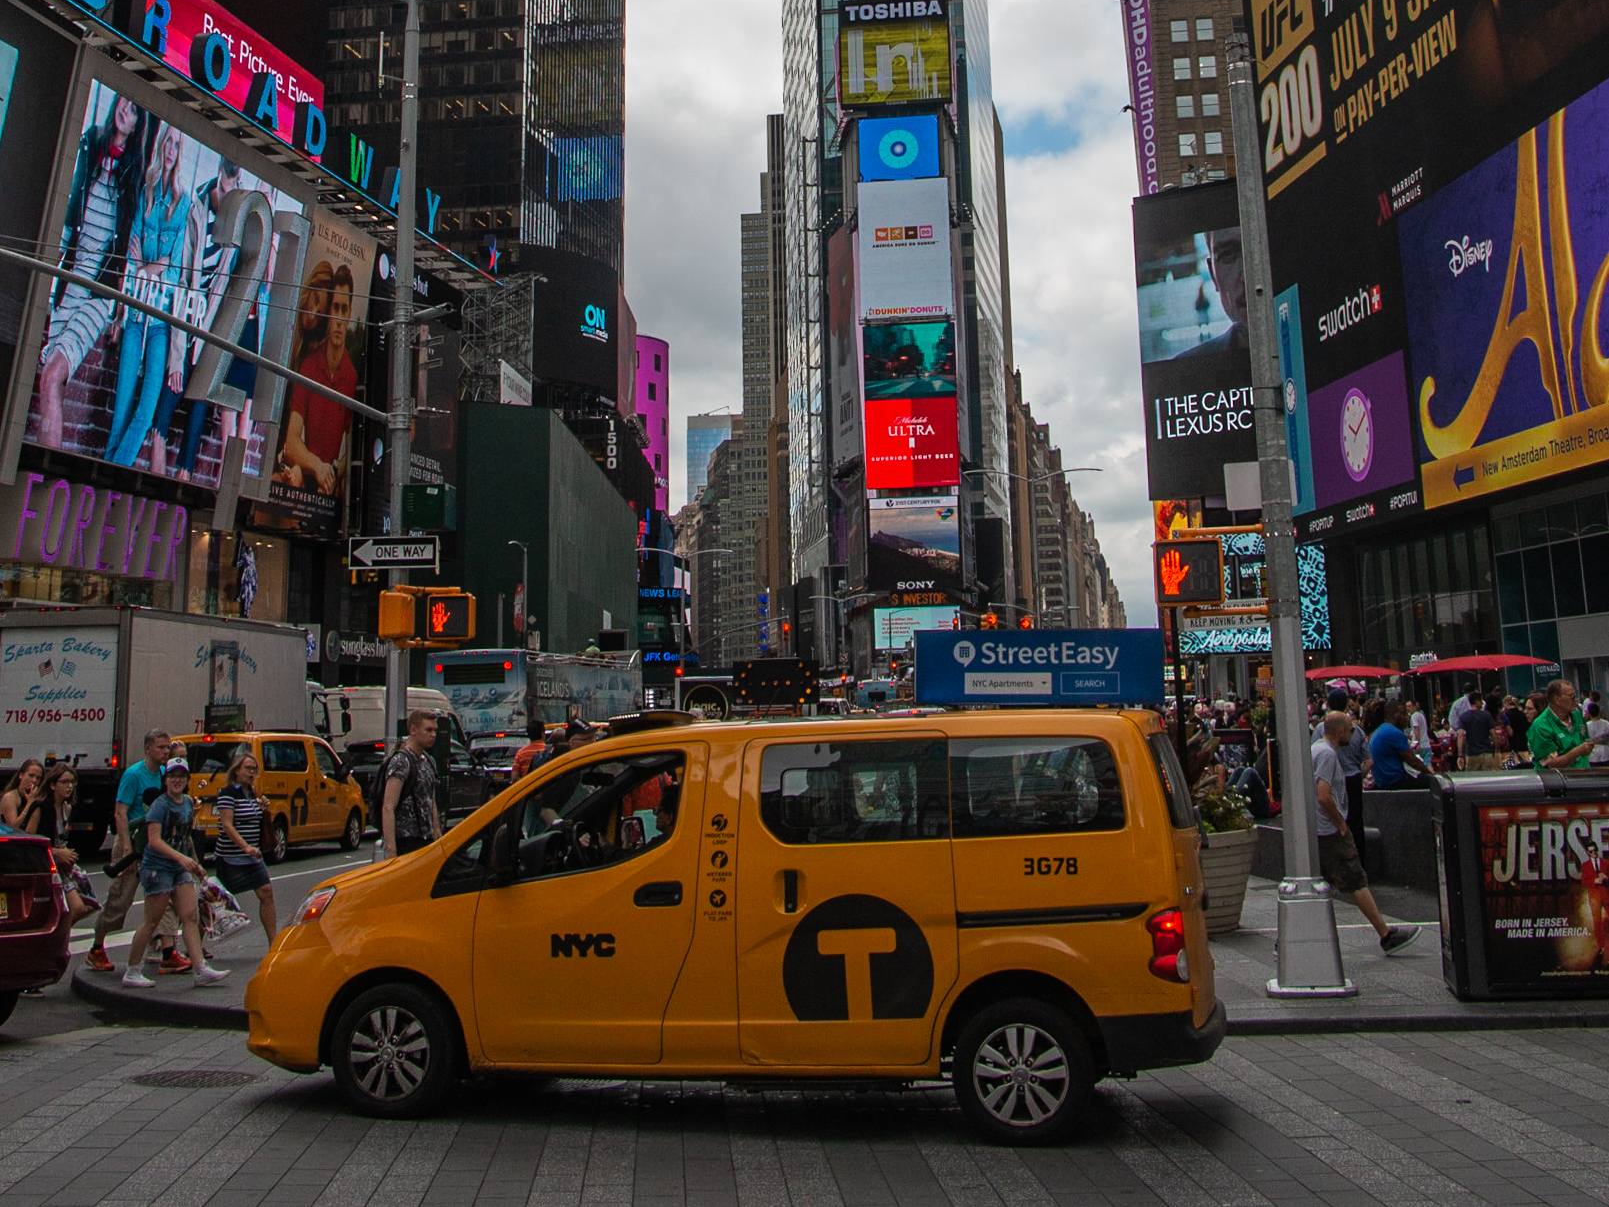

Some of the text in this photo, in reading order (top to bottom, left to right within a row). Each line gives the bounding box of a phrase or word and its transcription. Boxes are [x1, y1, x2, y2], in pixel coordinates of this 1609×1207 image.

[845, 0, 943, 22] TOSHIBA
[1333, 9, 1458, 134] ON PAY-PER-VIEW
[1261, 45, 1323, 174] 200
[1391, 166, 1424, 197] MARRIOTT
[1392, 184, 1422, 212] MARQUIS
[330, 231, 349, 252] POLO
[584, 304, 606, 330] ON
[875, 305, 944, 316] DUNKIN' DONUTS
[1318, 288, 1371, 342] swatch
[1164, 394, 1199, 416] THE
[888, 424, 936, 437] ULTRA
[1166, 409, 1253, 438] LEXUS RC
[606, 419, 617, 469] 1500
[1481, 461, 1499, 477] New
[1501, 446, 1548, 472] Amsterdam
[1548, 435, 1588, 457] Theatre,
[286, 490, 336, 508] AUTHENTICALLY
[1345, 502, 1371, 523] swatch
[13, 472, 187, 581] FOREVER
[375, 545, 426, 558] ONE WAY
[639, 588, 665, 599] NEWS
[896, 580, 936, 590] SONY
[1190, 614, 1236, 628] KEEP MOVING
[3, 637, 112, 663] Sparta Bakery
[340, 635, 376, 662] sunglass
[643, 651, 661, 662] JFK
[981, 641, 1119, 670] StreetEasy
[1535, 663, 1561, 674] VORNADO
[24, 685, 88, 703] Supplies
[972, 680, 1106, 689] NYC Apartments SEARCH
[5, 707, 106, 725] 718/956-4500
[1023, 857, 1079, 876] 3G78
[1495, 917, 1569, 929] BORN IN JERSEY.
[1507, 927, 1592, 939] MADE IN AMERICA.
[551, 933, 616, 958] NYC
